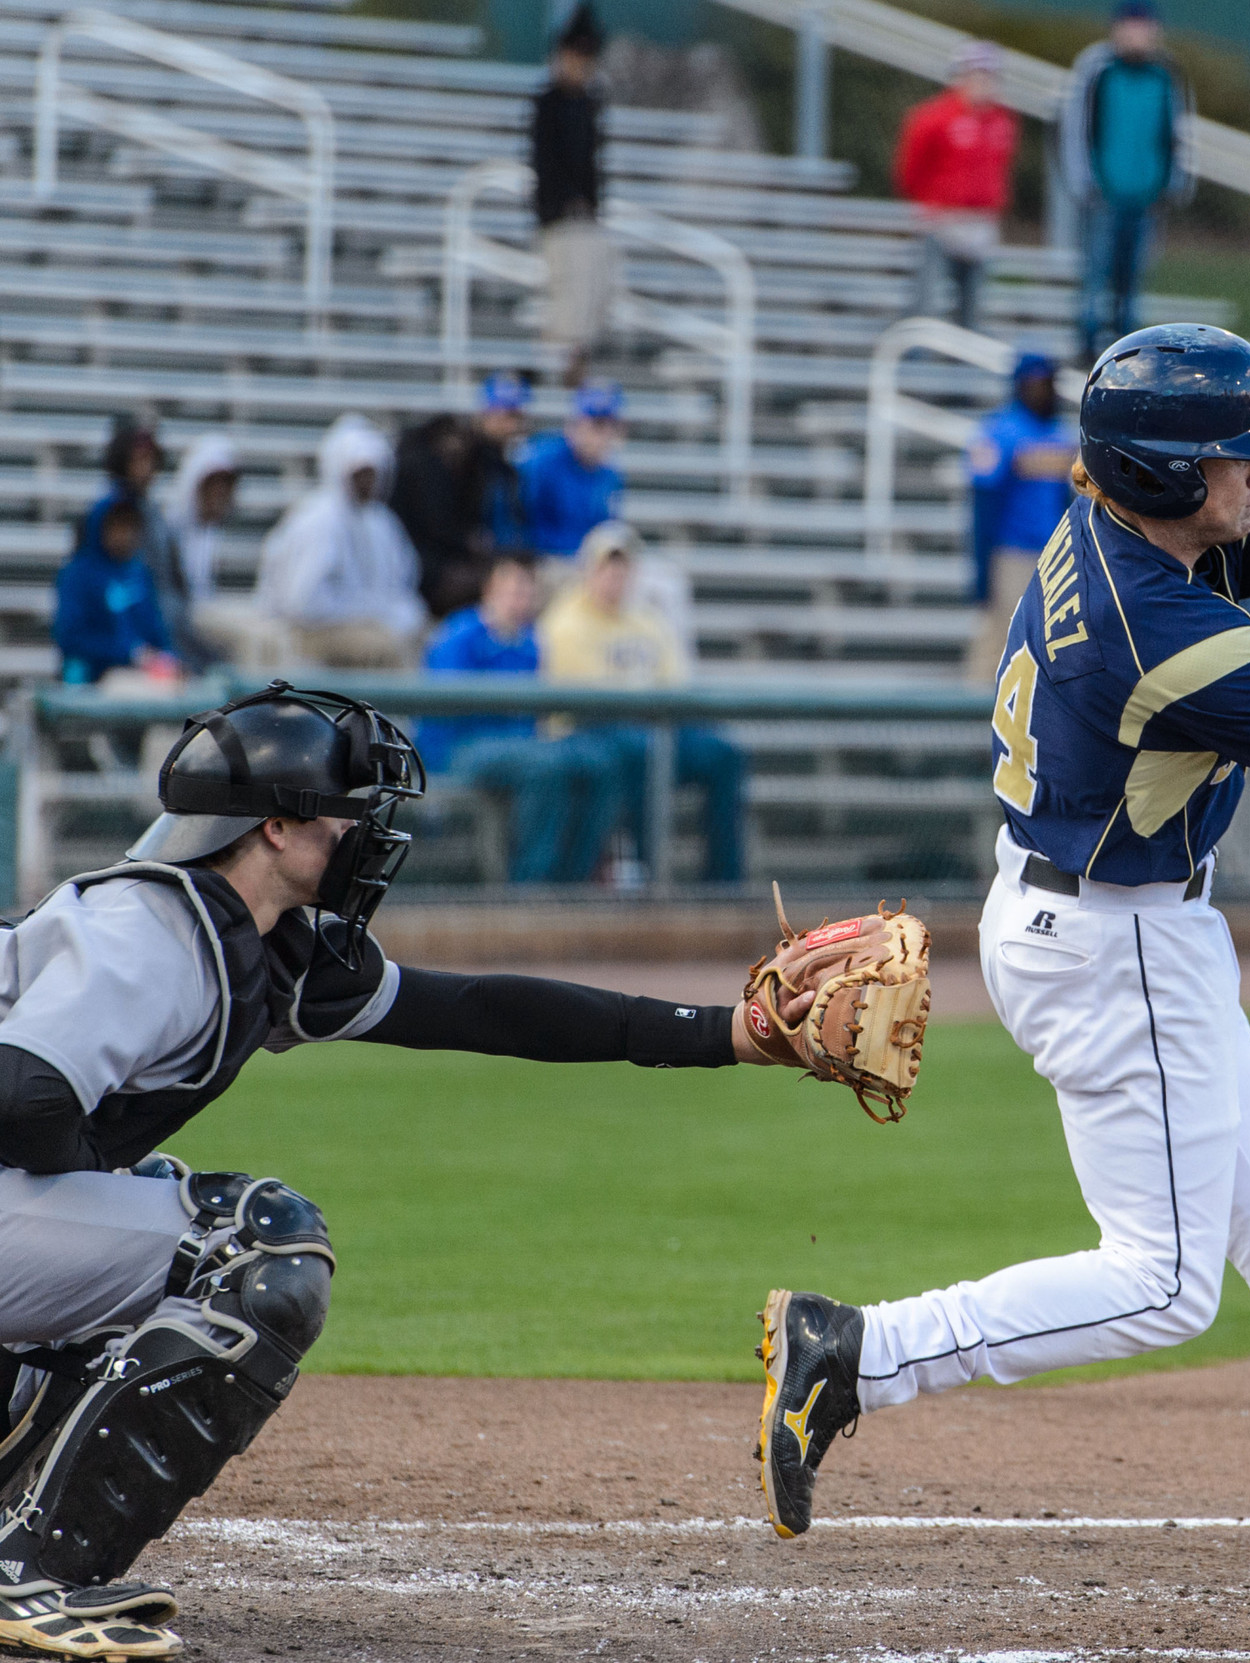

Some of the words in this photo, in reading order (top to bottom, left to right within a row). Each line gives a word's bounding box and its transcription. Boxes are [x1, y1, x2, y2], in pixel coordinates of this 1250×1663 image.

[1037, 509, 1089, 662] NZALEZ
[1025, 926, 1058, 938] RUSSELL
[150, 1378, 171, 1394] PRO
[170, 1366, 203, 1385] SERIES
